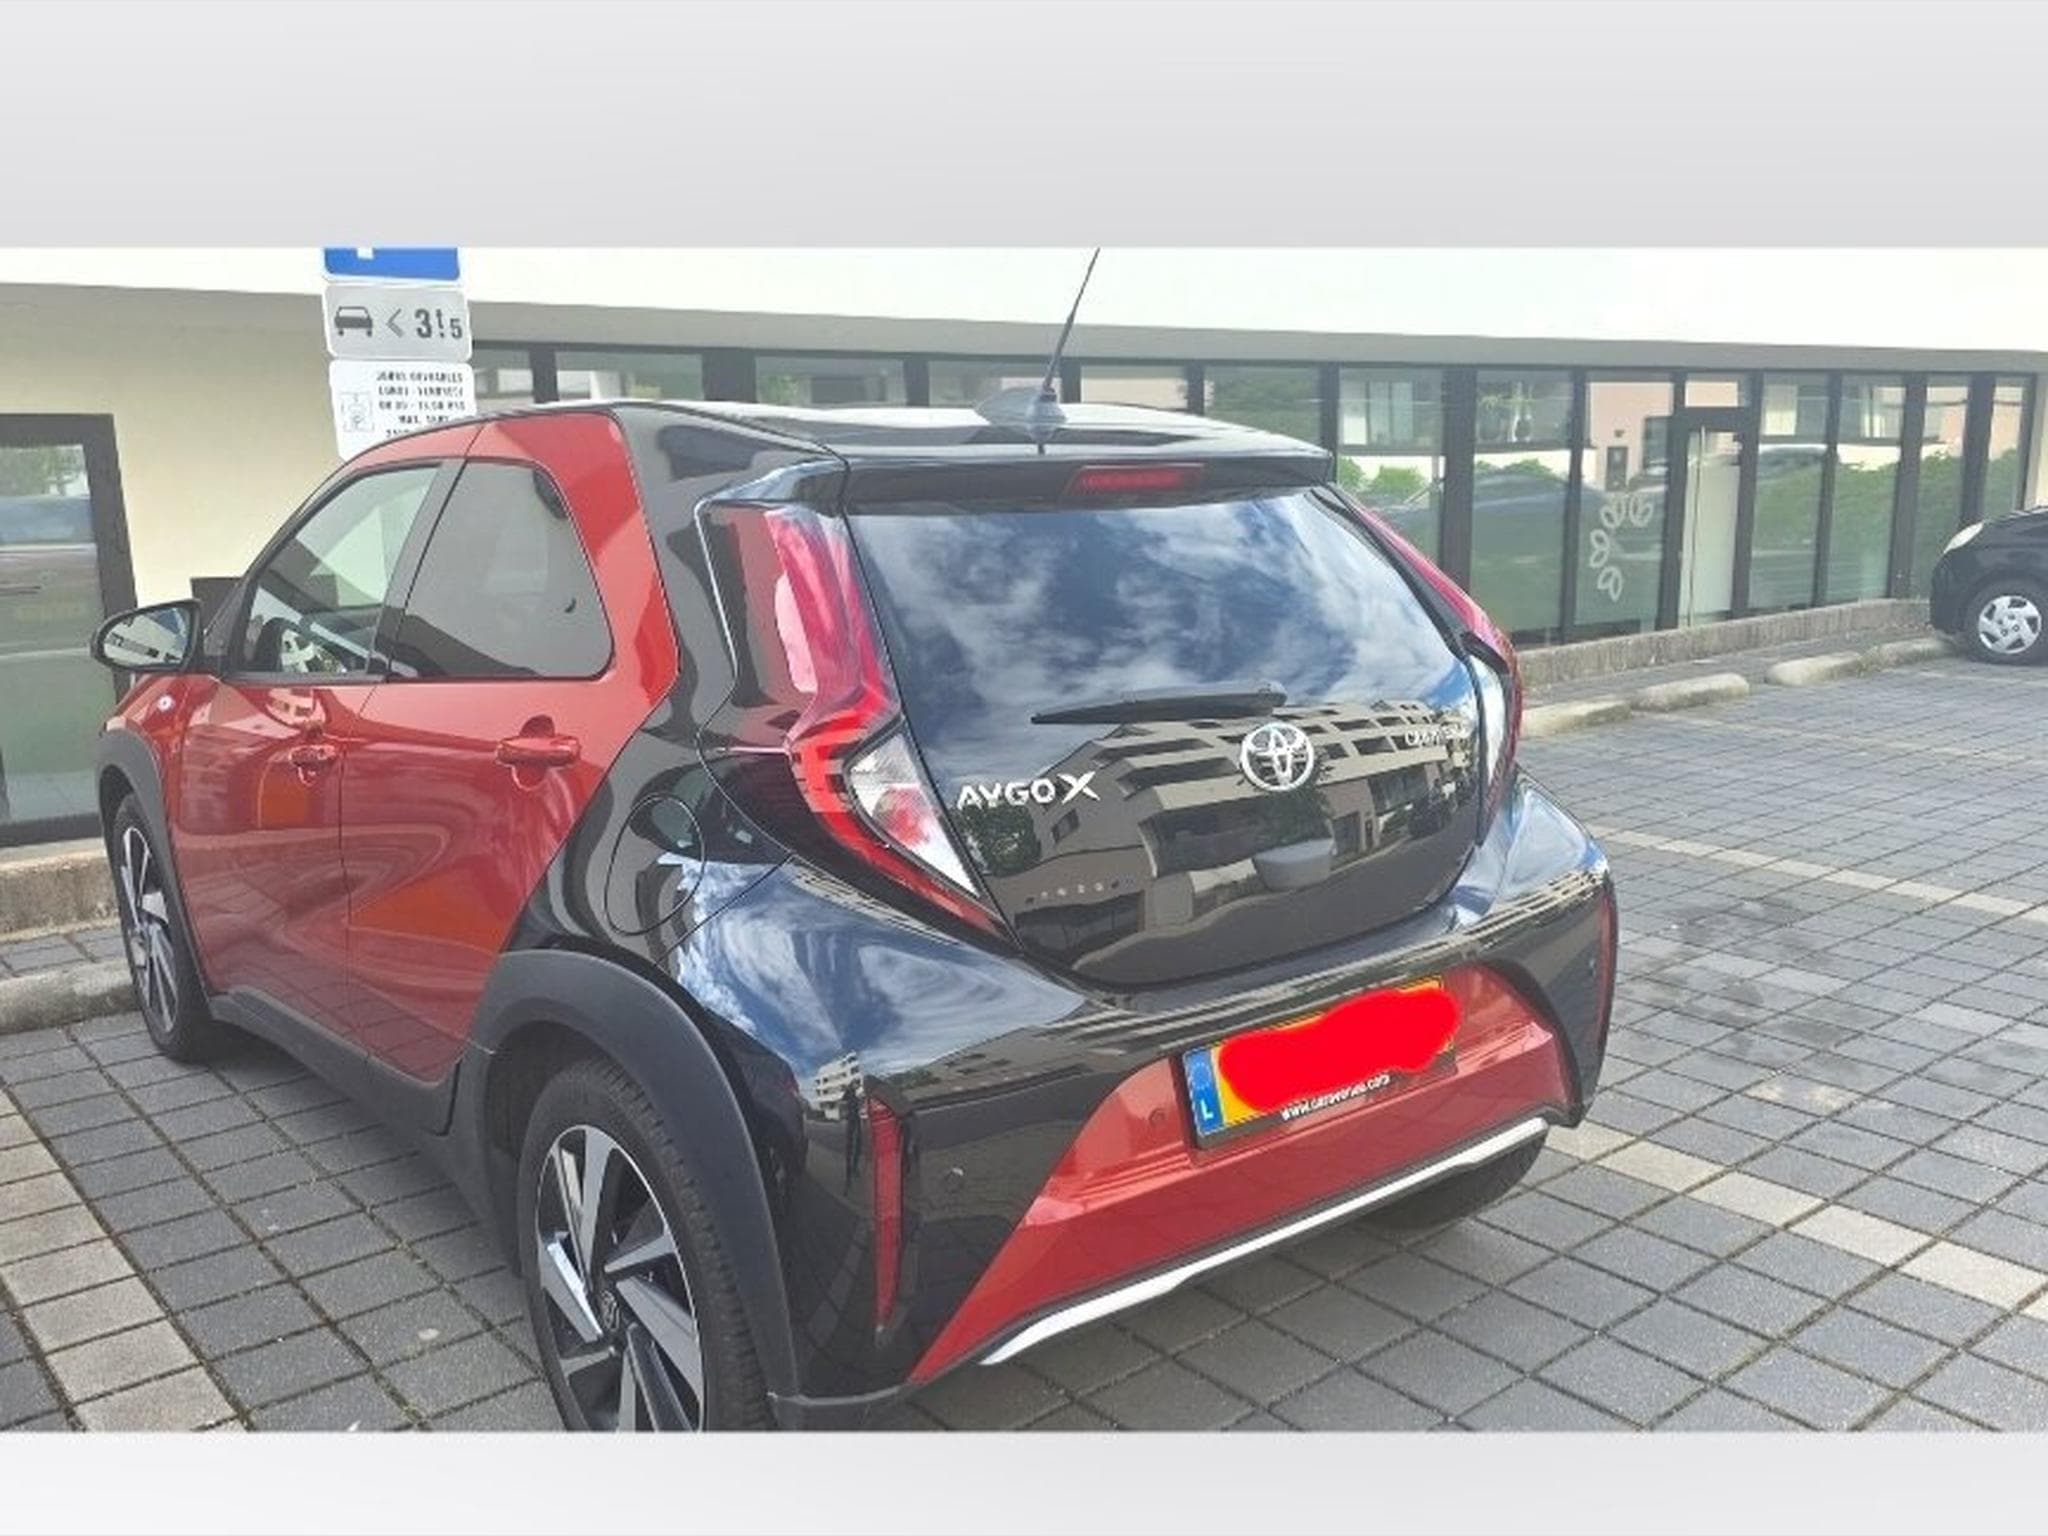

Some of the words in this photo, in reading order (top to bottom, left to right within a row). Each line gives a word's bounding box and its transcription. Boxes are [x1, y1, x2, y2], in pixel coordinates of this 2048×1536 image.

[956, 778, 1056, 811] AYGO
[1057, 770, 1101, 805] X
[1201, 1100, 1213, 1120] L
